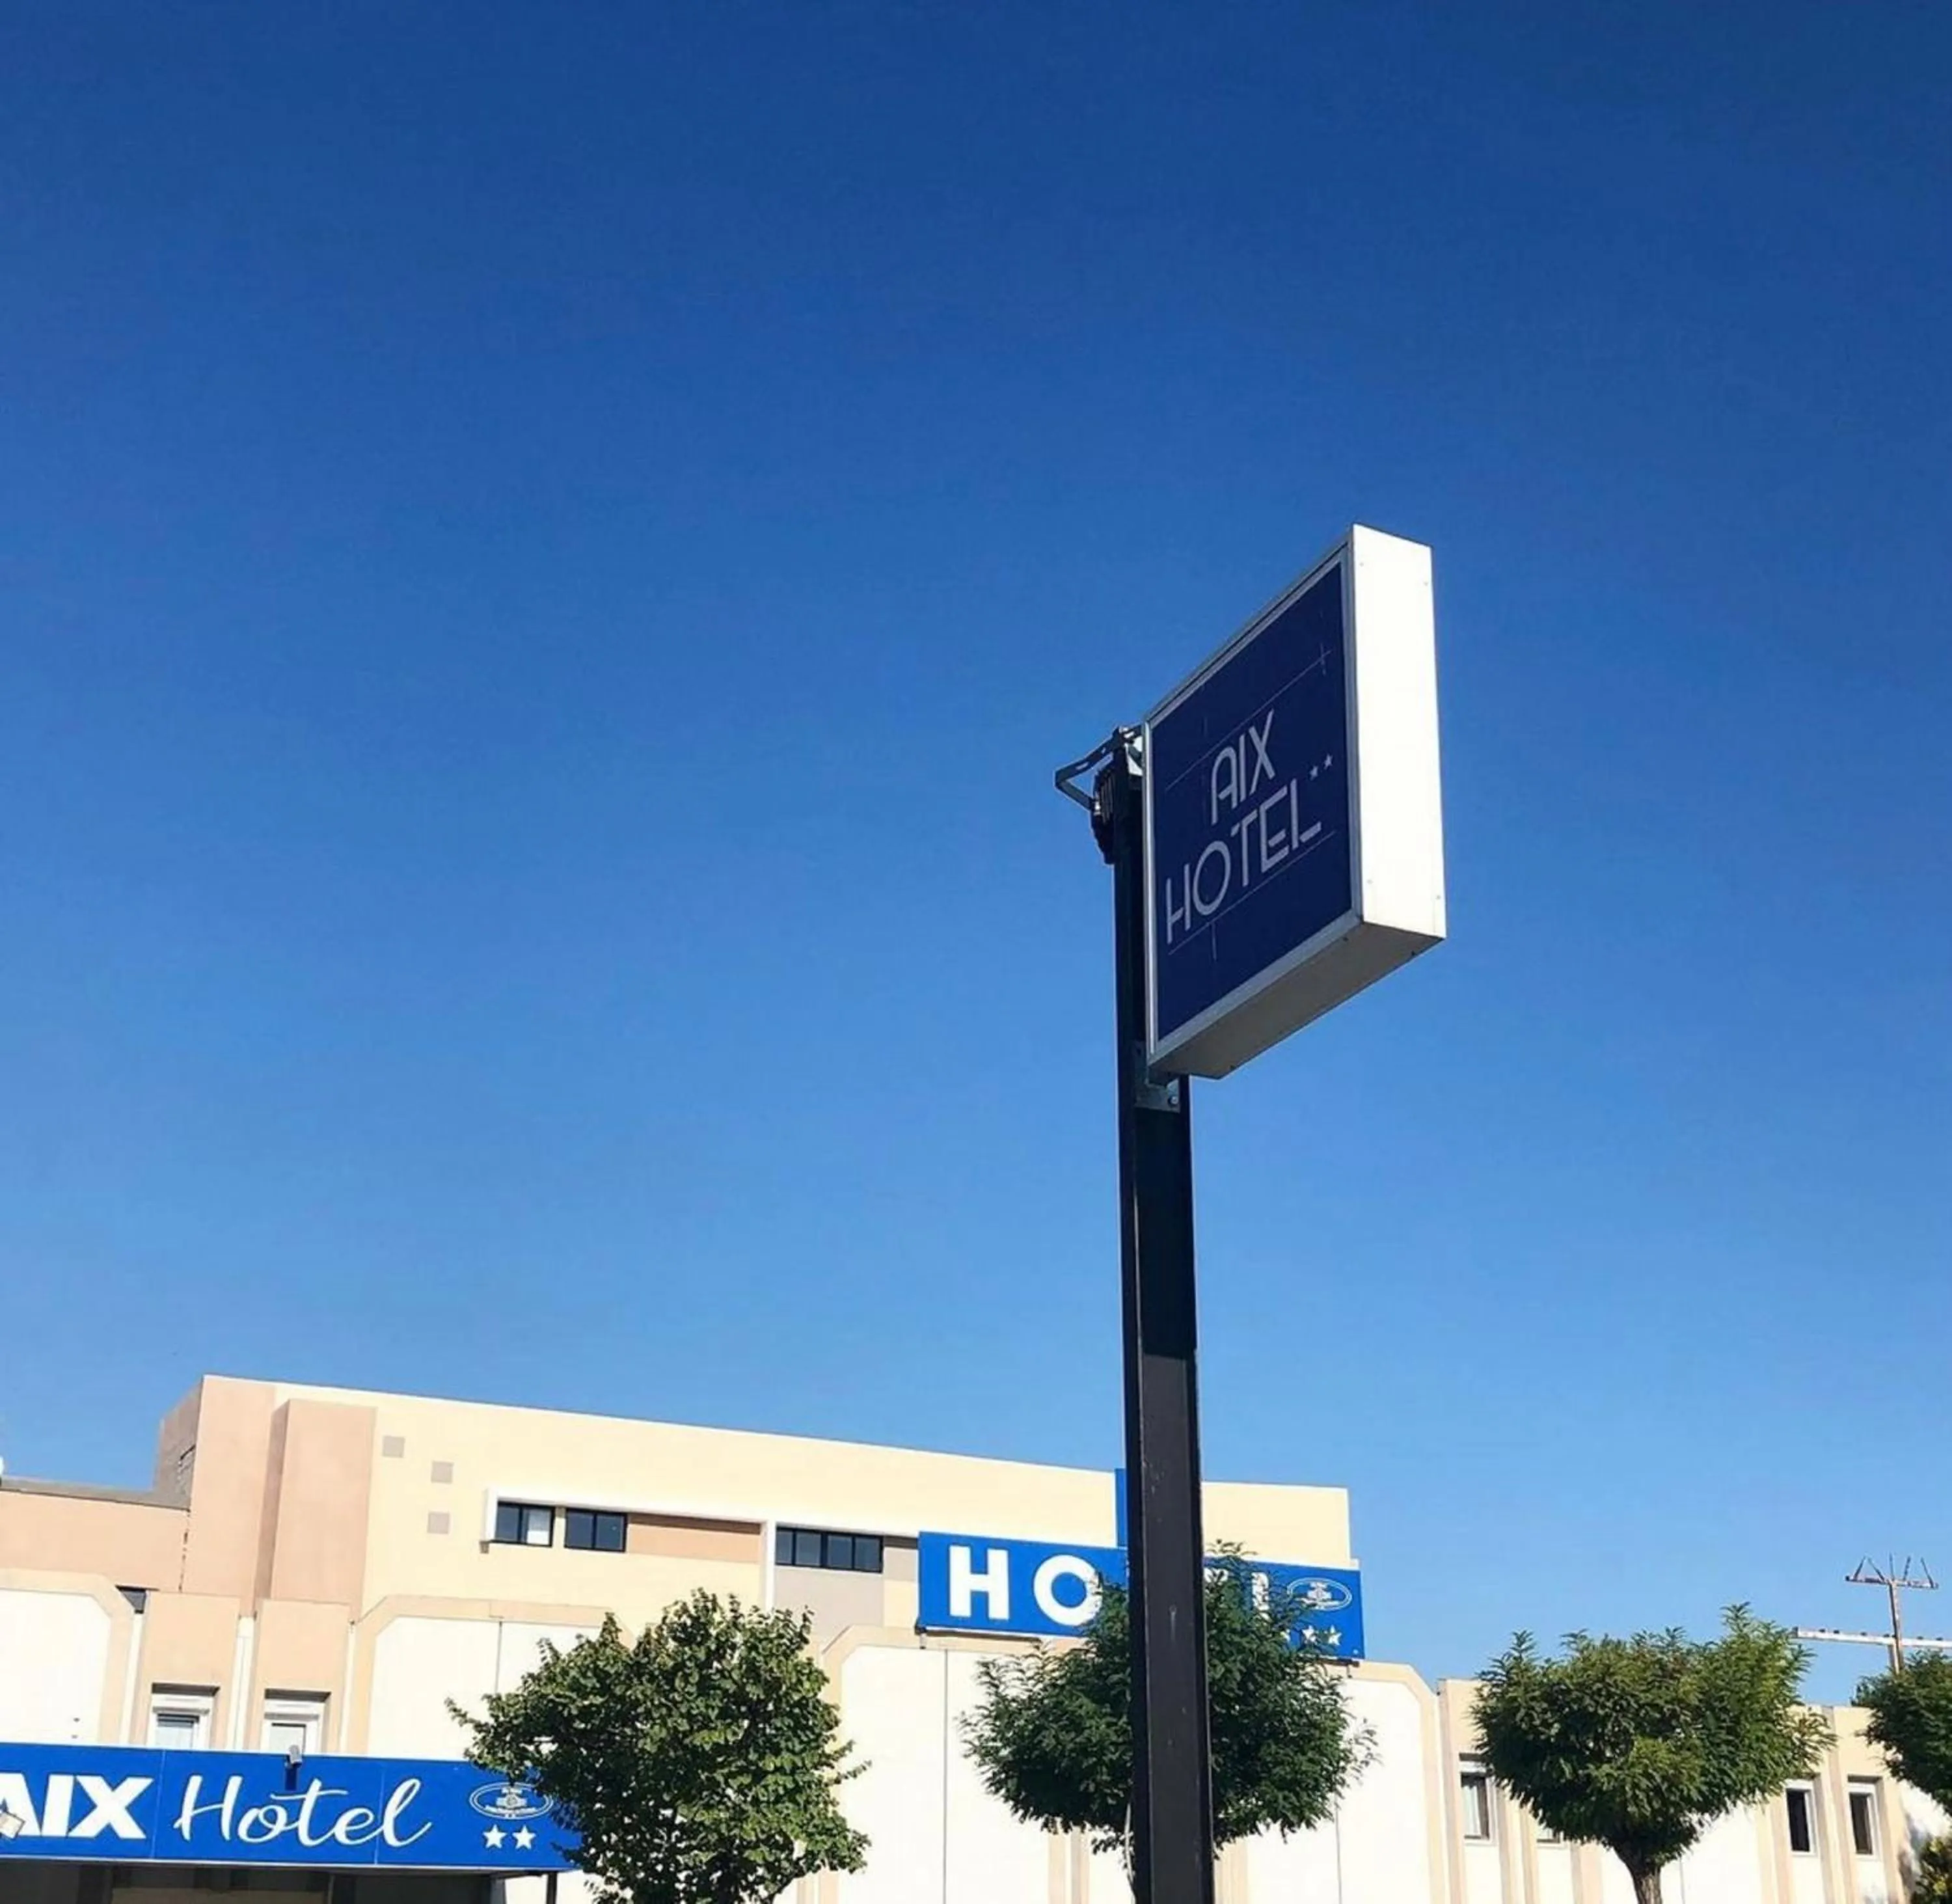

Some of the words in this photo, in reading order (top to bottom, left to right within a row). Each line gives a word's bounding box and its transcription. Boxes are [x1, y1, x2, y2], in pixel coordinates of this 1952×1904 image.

[1211, 709, 1275, 825] AIX
[1165, 778, 1322, 944] HOTEL
[174, 1775, 432, 1848] Hotel
